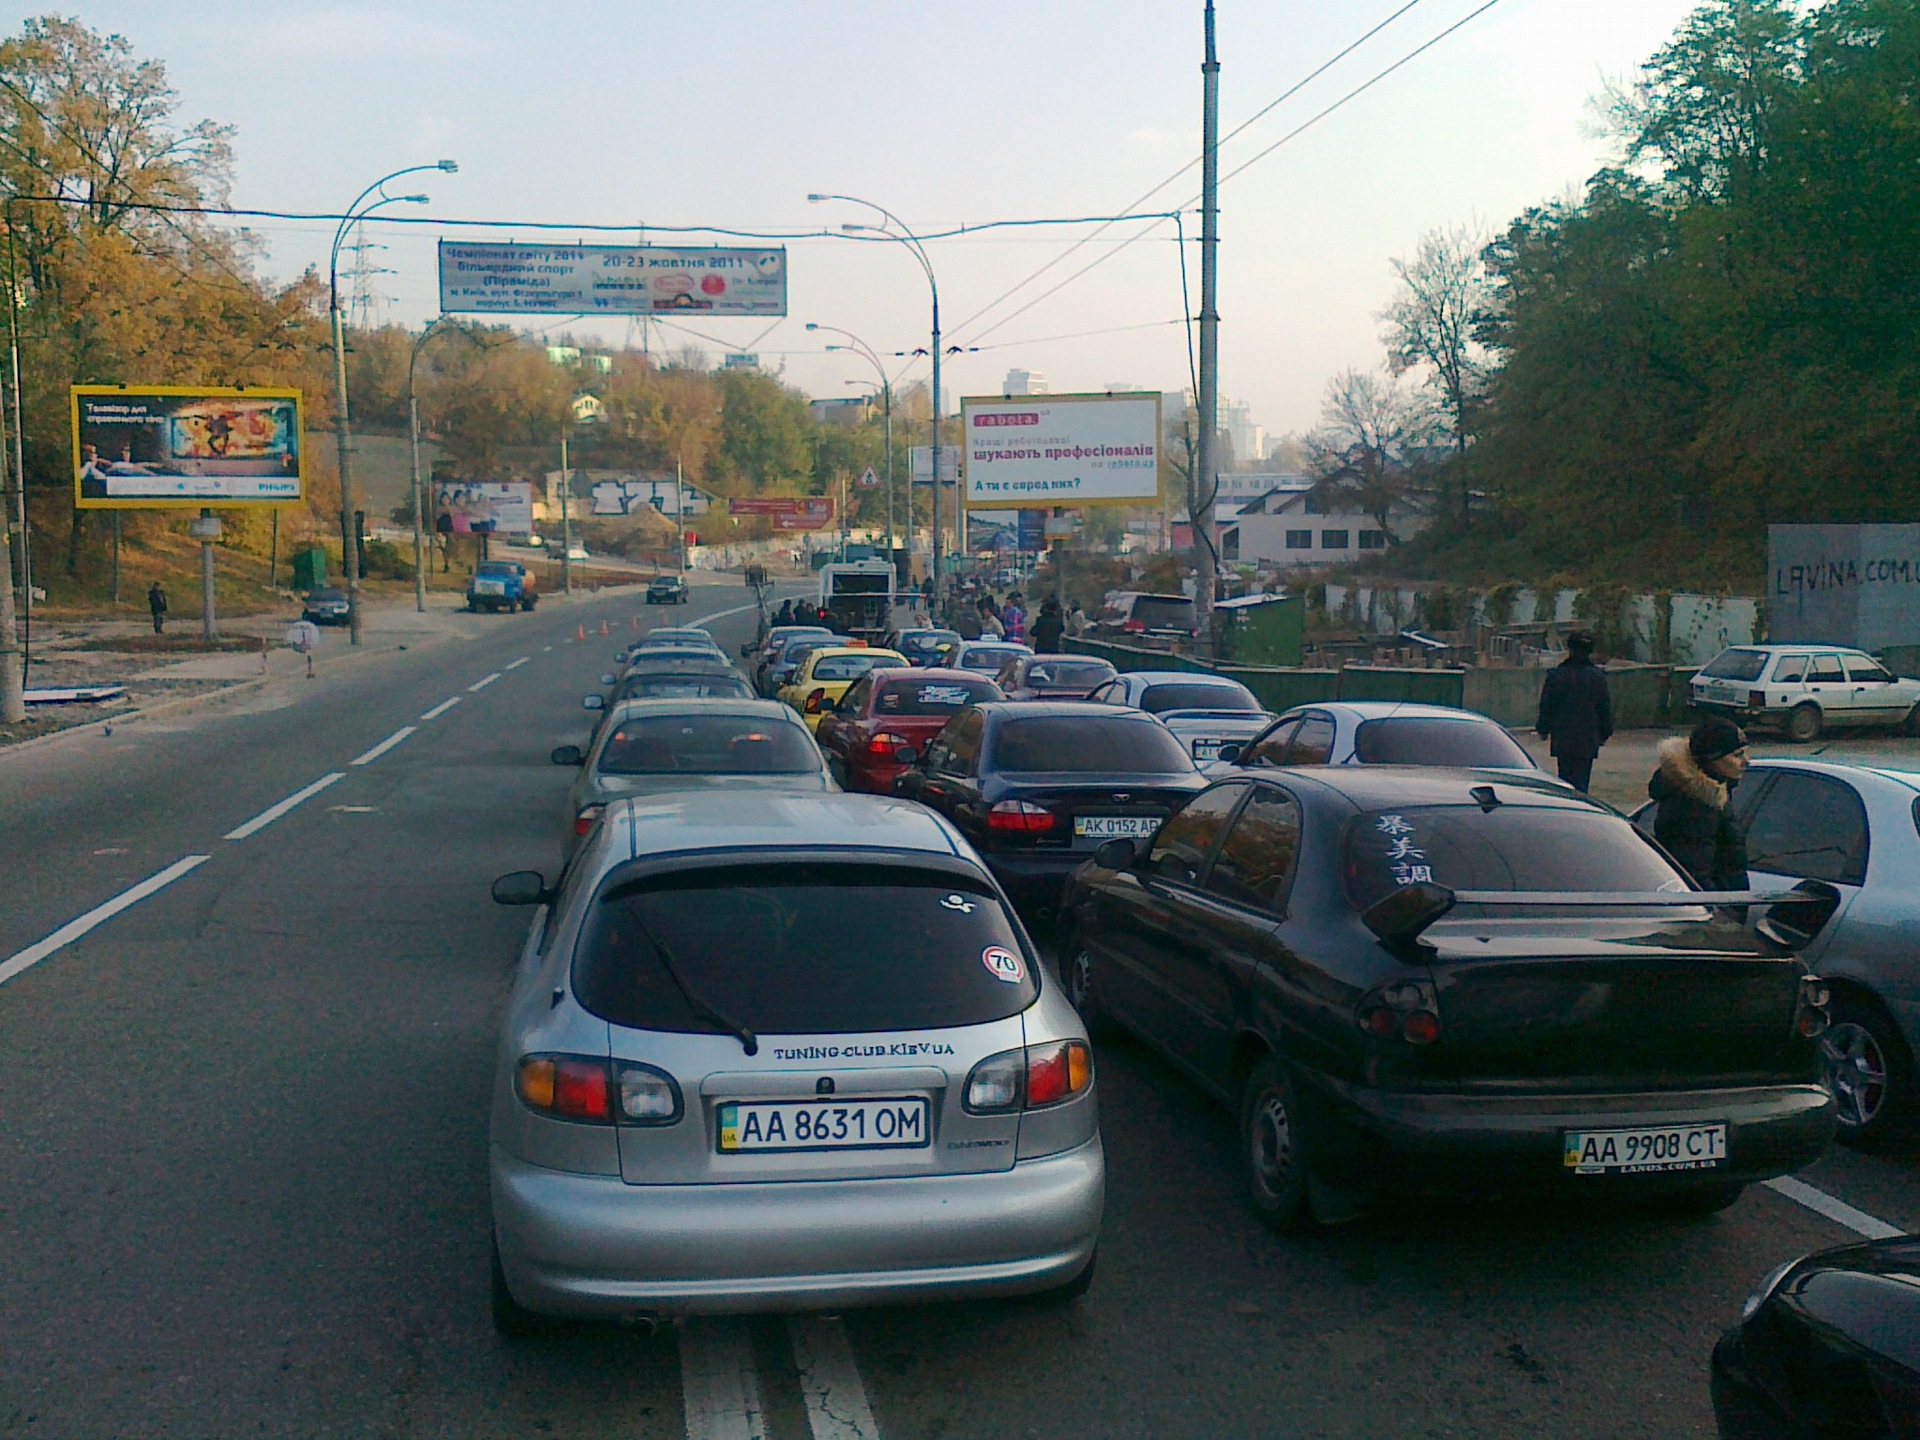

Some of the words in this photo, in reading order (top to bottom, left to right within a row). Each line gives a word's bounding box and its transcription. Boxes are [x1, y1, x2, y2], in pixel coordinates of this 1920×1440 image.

[519, 250, 550, 262] світу
[603, 255, 645, 267] 20-23
[649, 258, 705, 267] жовтня
[709, 256, 743, 268] 2011
[537, 265, 575, 275] спорт
[974, 449, 1041, 463] шукають
[1045, 442, 1154, 461] професіоналів
[975, 480, 983, 491] А
[986, 481, 999, 491] ти
[1012, 479, 1049, 492] серед
[1051, 477, 1081, 489] них?
[1085, 819, 1103, 833] AK
[1106, 819, 1137, 833] 0152
[990, 954, 1016, 971] 70
[742, 1110, 787, 1142] AA
[794, 1108, 865, 1140] 8631
[875, 1107, 920, 1138] OM
[1581, 1137, 1618, 1163] AA
[1625, 1133, 1681, 1161] 9908
[1686, 1128, 1720, 1156] CT
